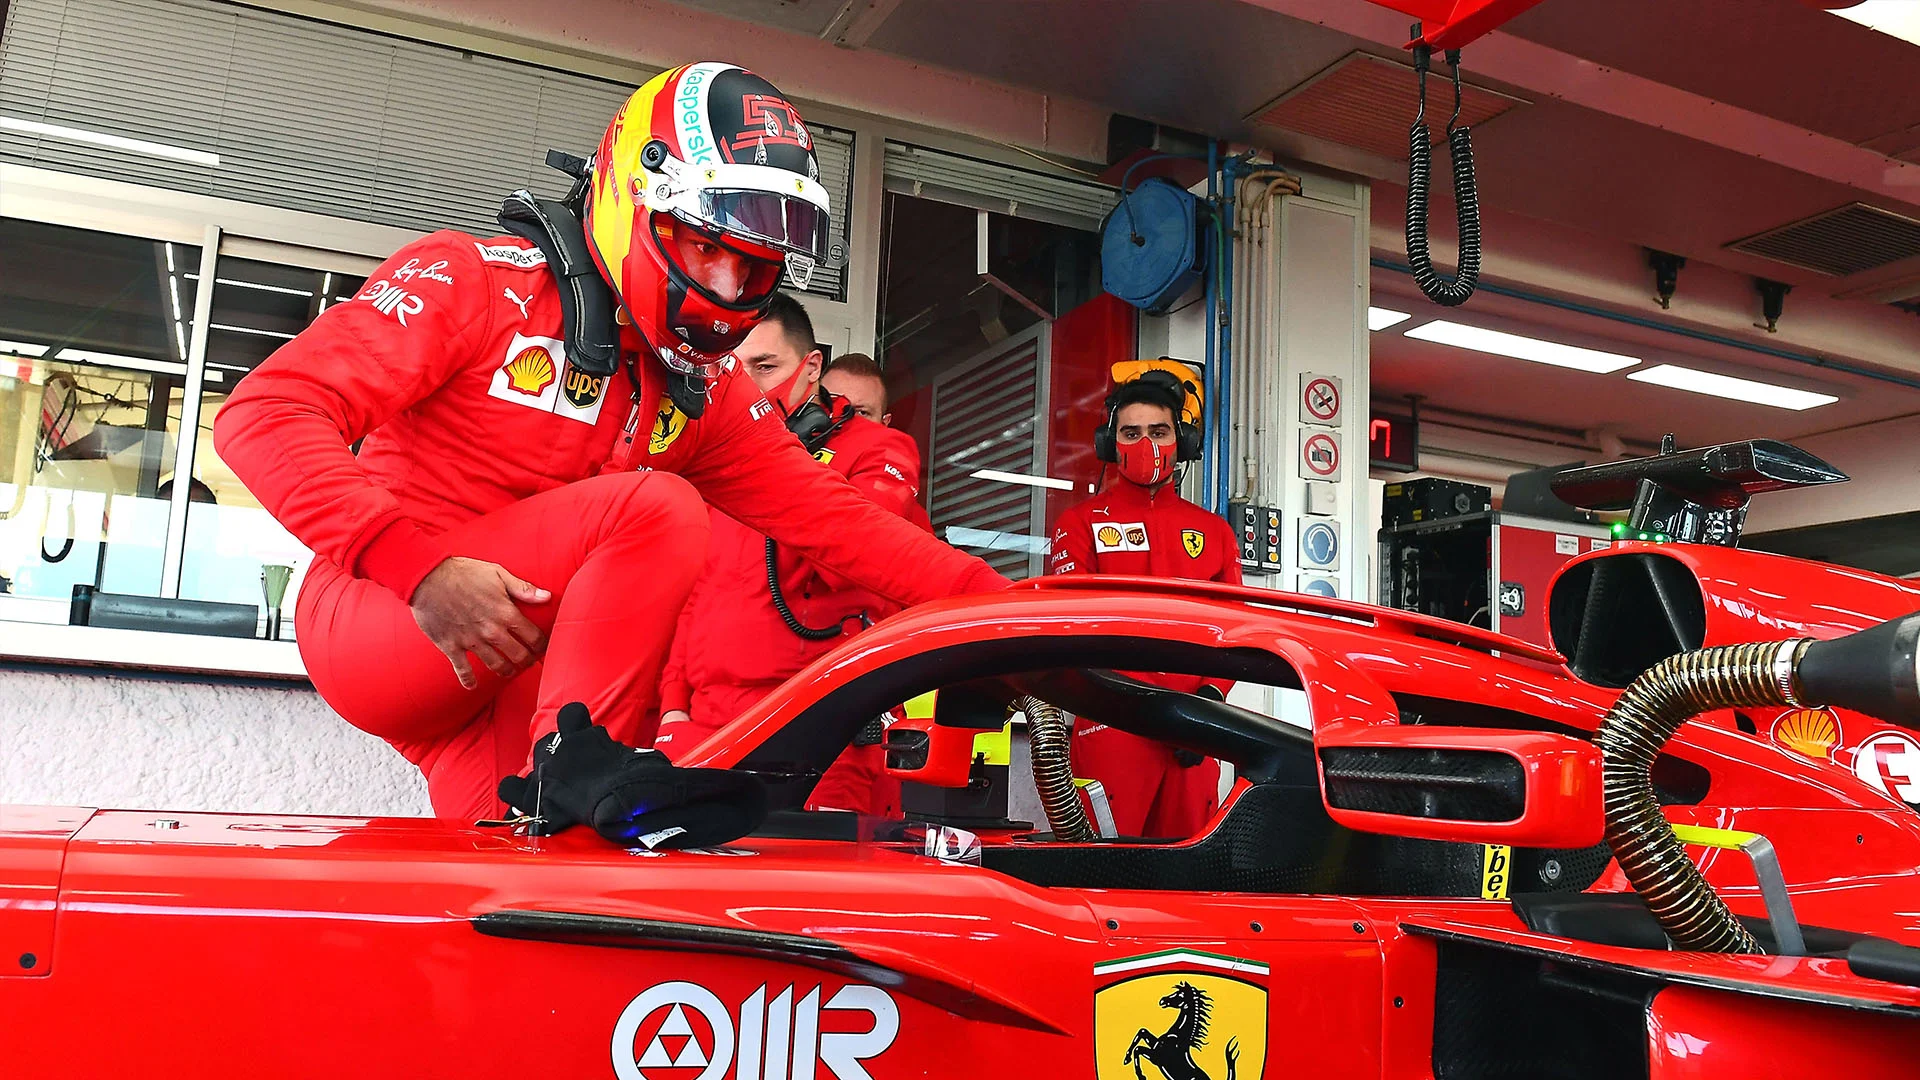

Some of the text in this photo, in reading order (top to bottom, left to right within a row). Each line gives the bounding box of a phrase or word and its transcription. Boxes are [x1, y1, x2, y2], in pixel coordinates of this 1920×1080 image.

[567, 370, 600, 400] ups
[1127, 532, 1144, 544] ups
[1486, 845, 1506, 899] be
